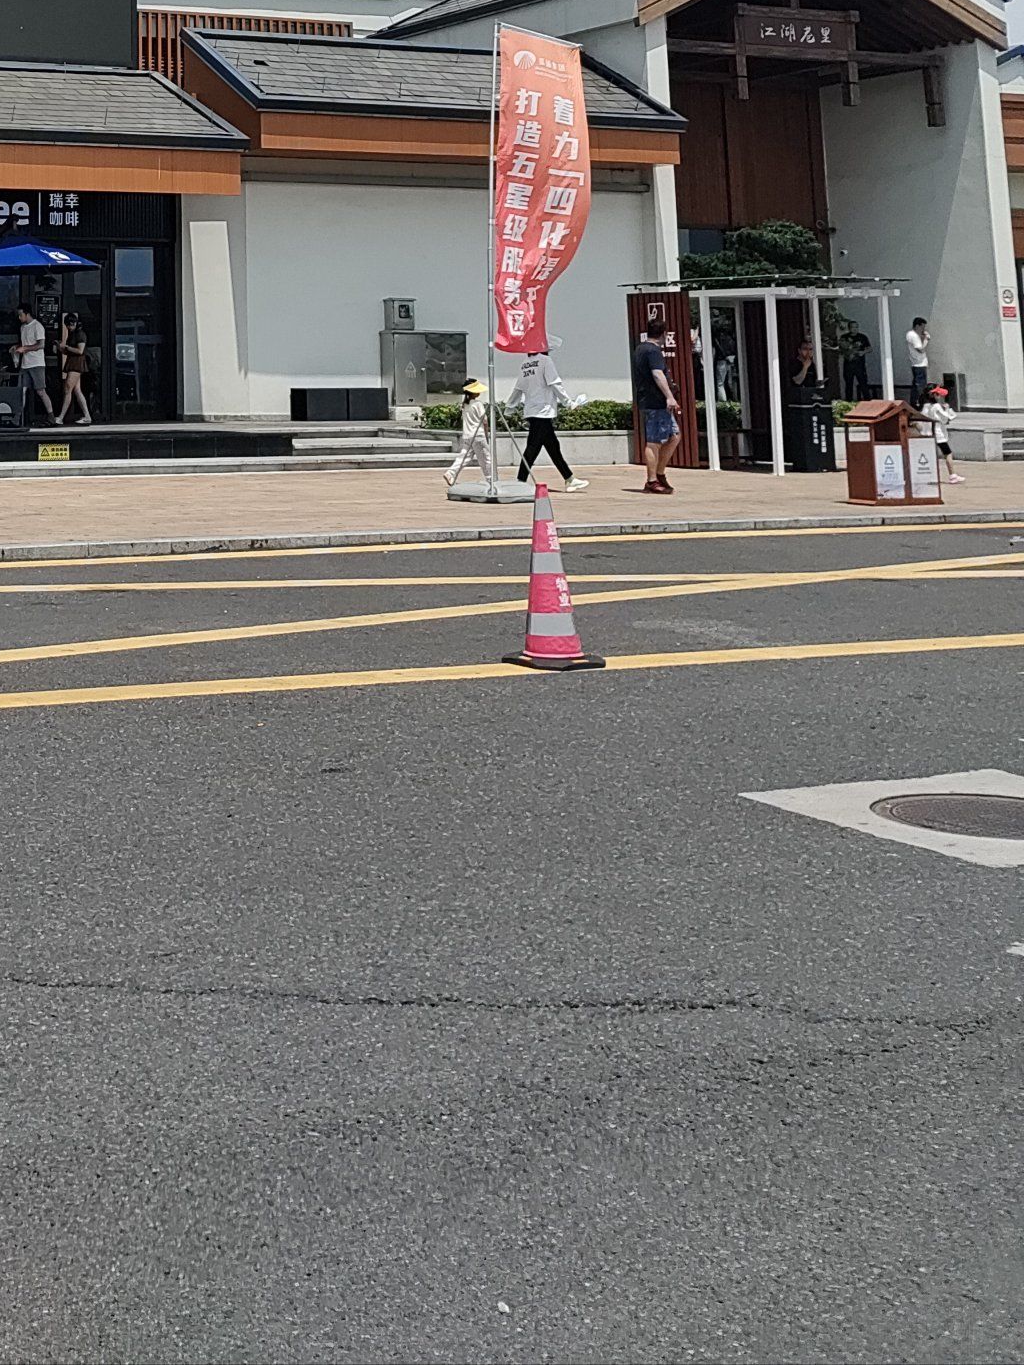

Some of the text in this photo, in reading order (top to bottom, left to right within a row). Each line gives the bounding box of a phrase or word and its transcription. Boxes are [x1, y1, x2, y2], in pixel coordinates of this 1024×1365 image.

[49, 192, 80, 209] 瑞幸
[49, 211, 80, 227] 咖啡
[502, 87, 543, 337] 打造五星级服务区
